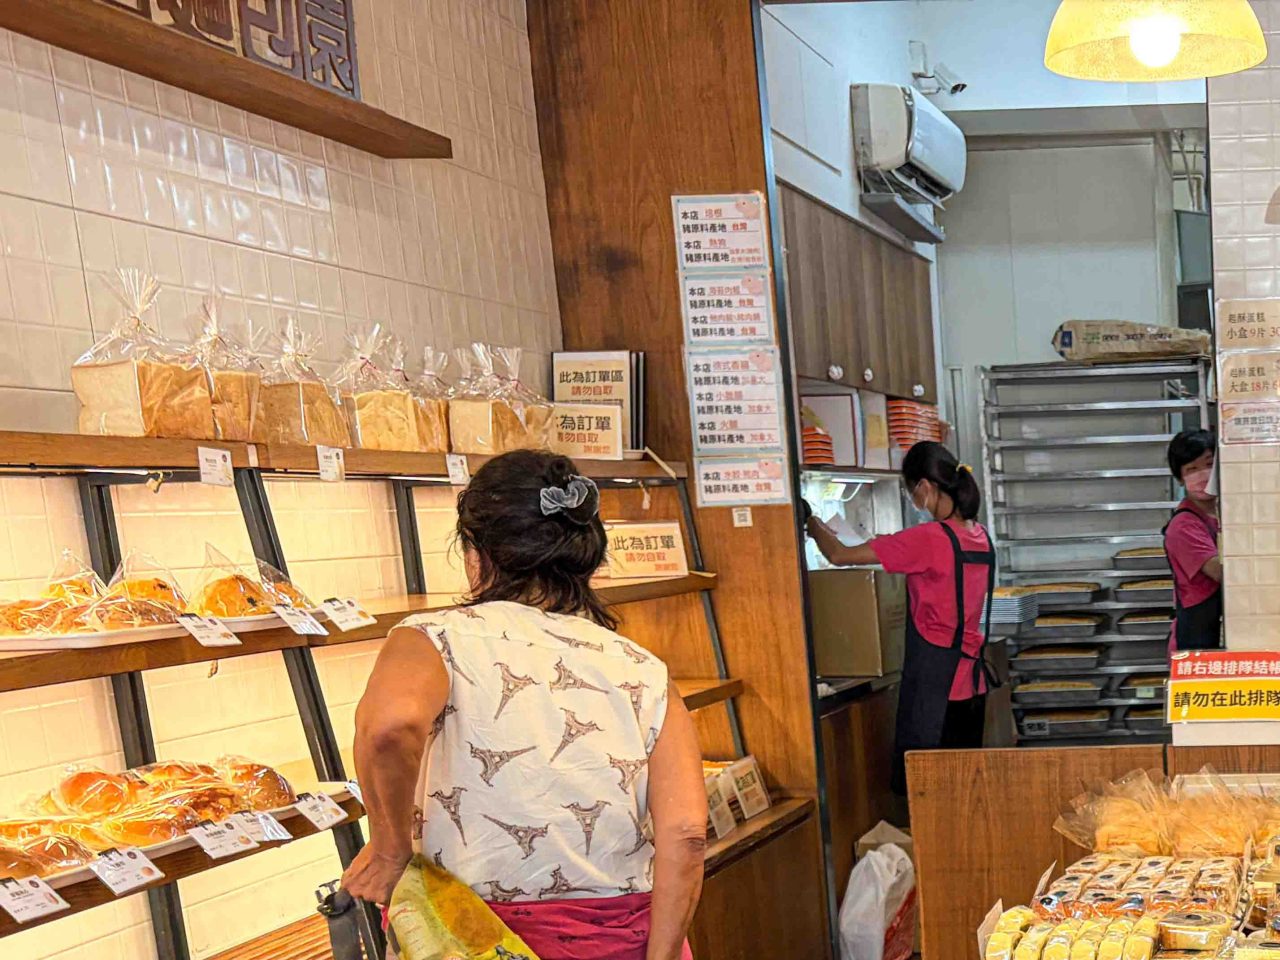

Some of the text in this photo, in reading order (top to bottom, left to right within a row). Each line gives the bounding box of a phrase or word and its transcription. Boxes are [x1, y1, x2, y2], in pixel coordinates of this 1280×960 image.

[681, 210, 699, 220] 本店
[684, 240, 701, 250] 本店
[688, 287, 705, 296] 本店
[691, 316, 708, 325] 本店
[693, 363, 711, 373] 本店
[559, 370, 624, 383] 此為訂單區
[571, 385, 613, 396] 請勿自取
[556, 415, 611, 431] 為訂單
[698, 422, 716, 431] 本店
[703, 472, 721, 481] 本店
[613, 535, 676, 550] 此為訂單
[625, 552, 666, 562] 請勿自取
